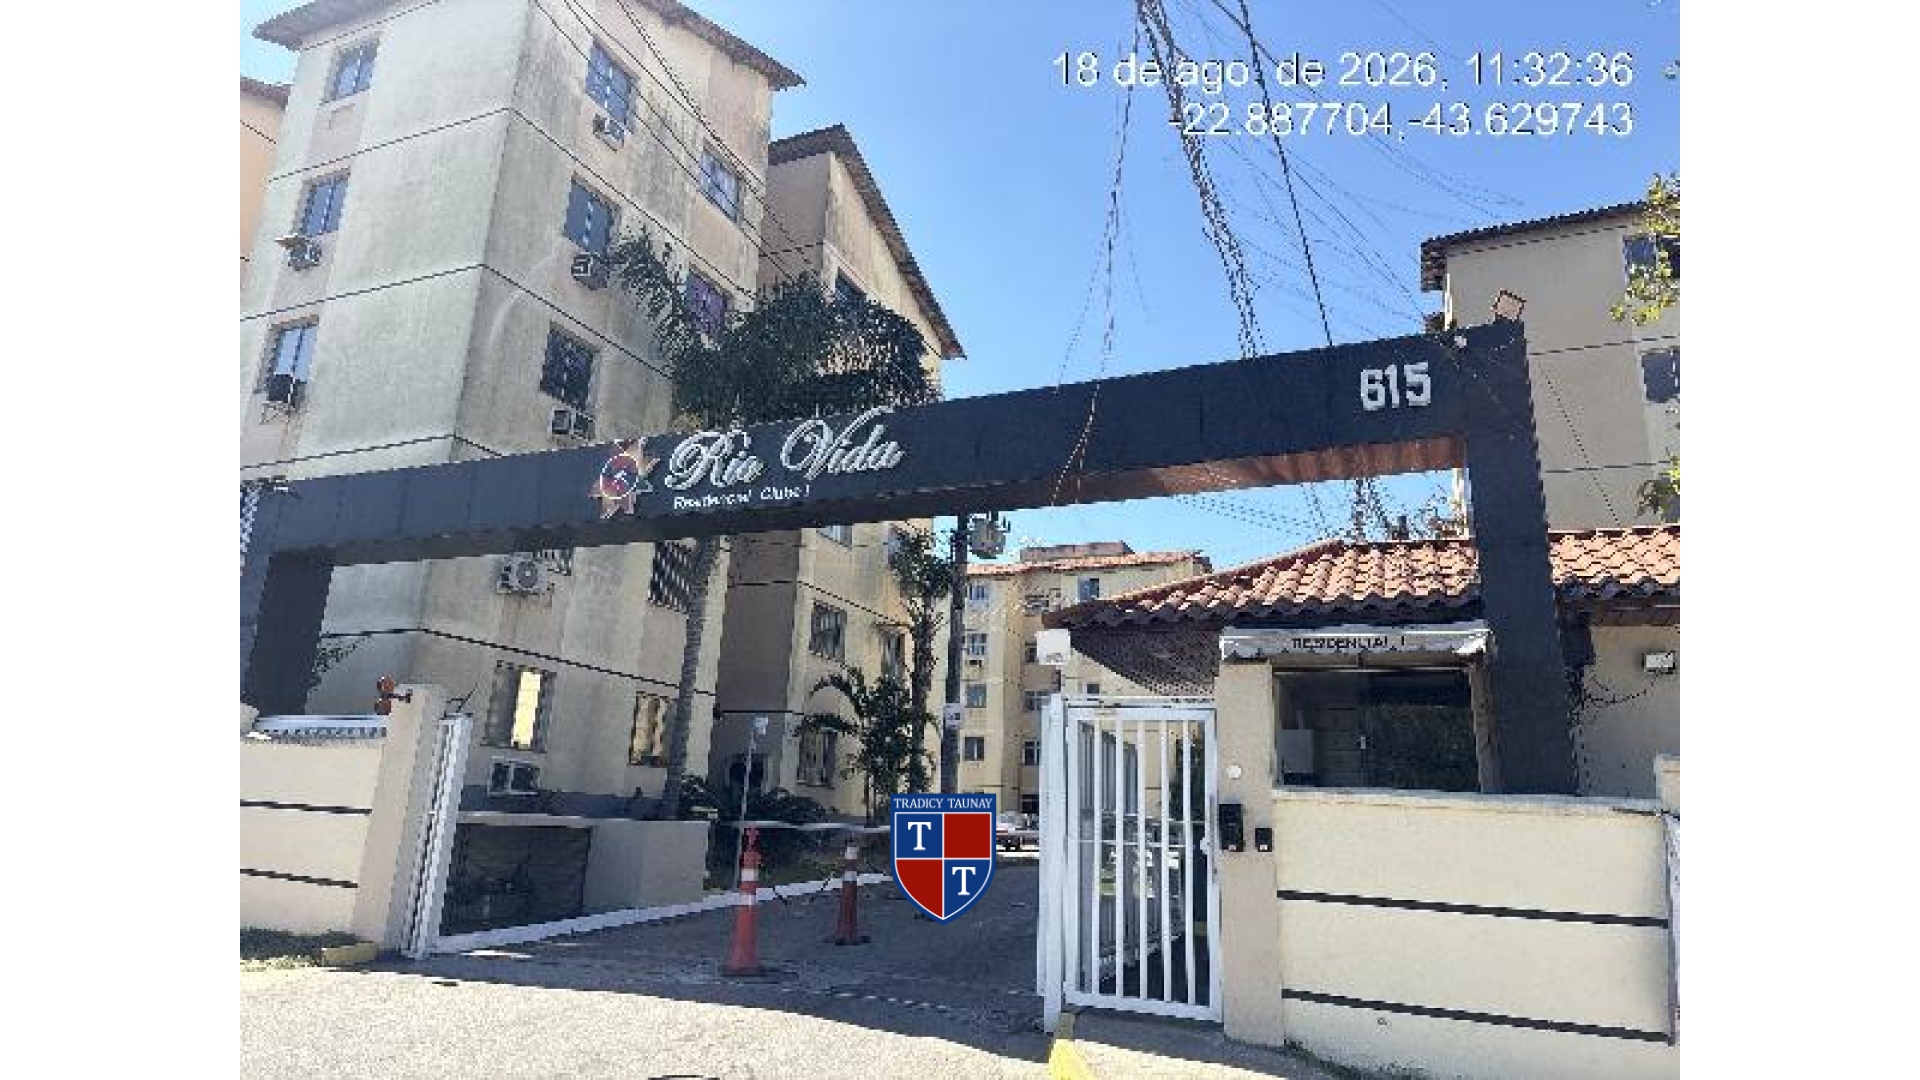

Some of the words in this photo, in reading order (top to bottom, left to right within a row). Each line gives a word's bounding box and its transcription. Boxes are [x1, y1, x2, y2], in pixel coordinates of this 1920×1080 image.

[1360, 361, 1431, 411] 615
[664, 429, 764, 490] Rio
[779, 405, 905, 480] Vida
